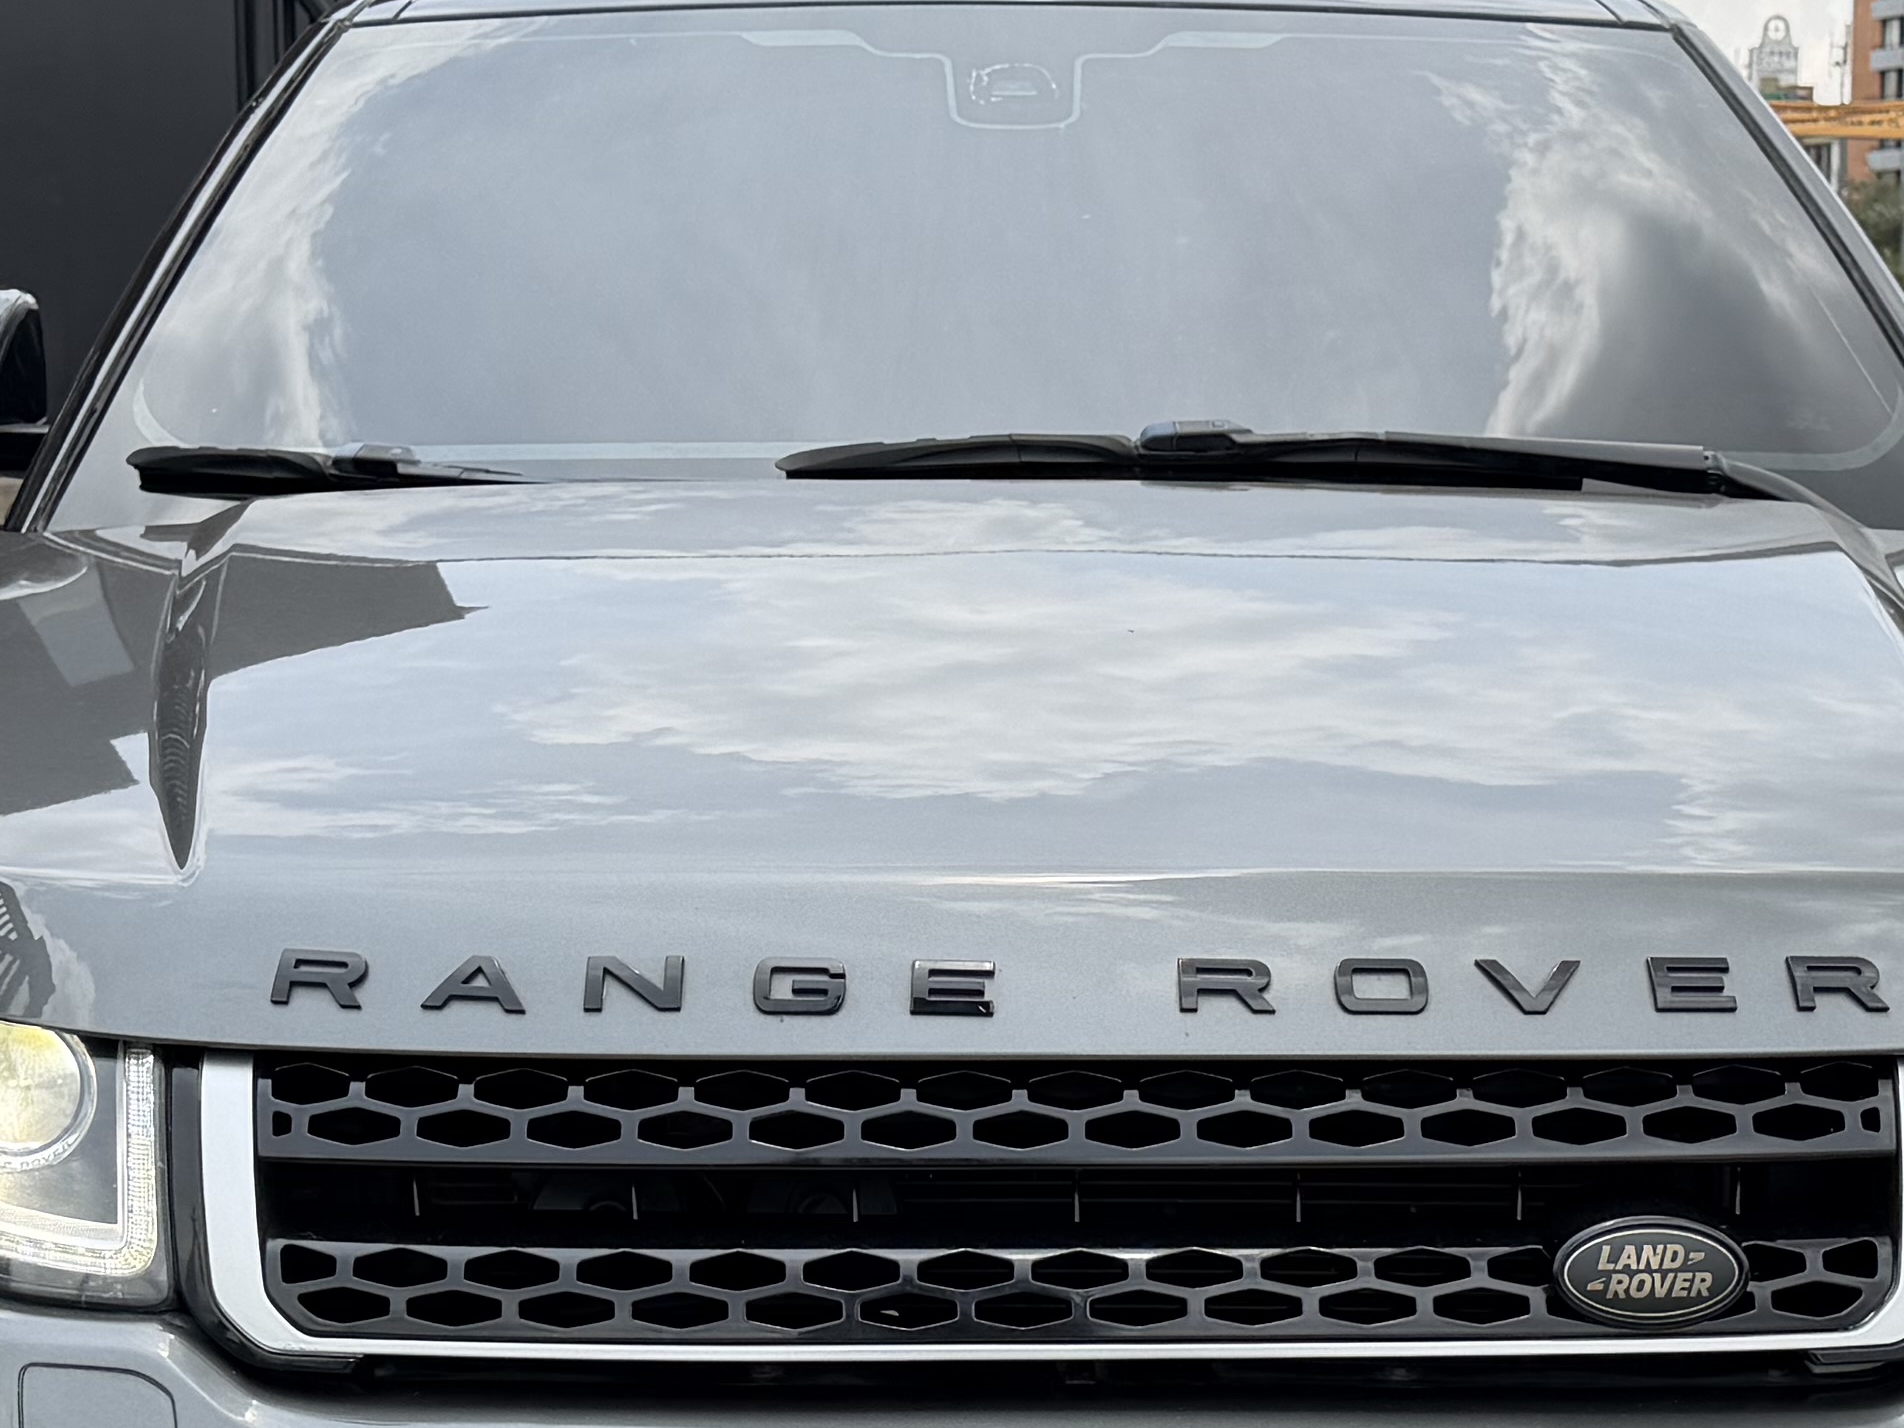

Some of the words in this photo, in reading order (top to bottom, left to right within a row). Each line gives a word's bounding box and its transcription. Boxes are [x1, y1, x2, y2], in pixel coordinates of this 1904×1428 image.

[270, 948, 998, 1017] RANGE
[1176, 953, 1892, 1016] ROVER
[1597, 1244, 1685, 1271] LAND
[1605, 1271, 1713, 1300] ROVER
